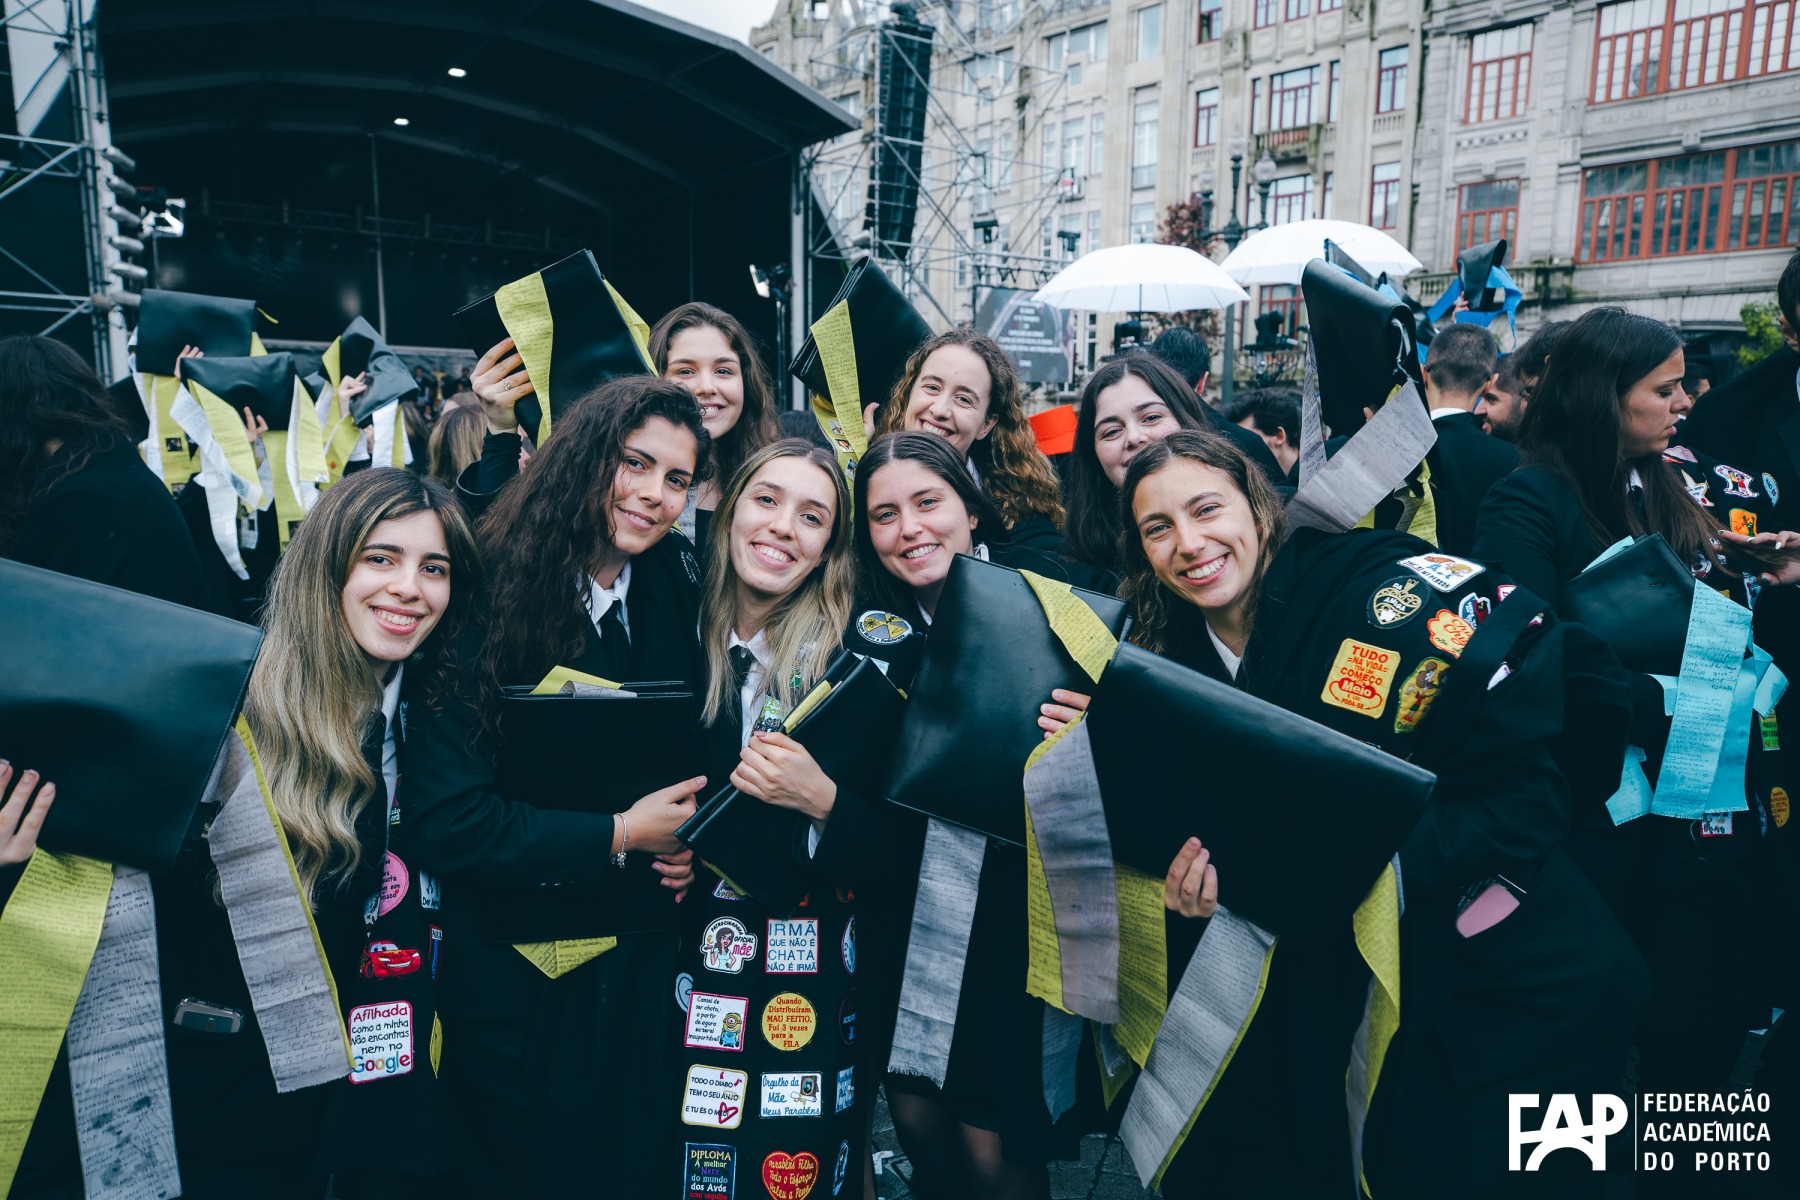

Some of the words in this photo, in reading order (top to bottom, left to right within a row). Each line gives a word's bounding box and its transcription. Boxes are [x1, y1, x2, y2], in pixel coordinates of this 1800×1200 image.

[1383, 597, 1406, 611] AMIGA
[1352, 645, 1388, 663] TUDO
[1366, 660, 1382, 672] VIDA
[1341, 667, 1382, 685] COMEÇO
[1342, 680, 1372, 697] Meio
[711, 920, 743, 935] PATROCINADORA
[769, 921, 816, 936] IRMÃ
[789, 938, 807, 946] NÃO
[810, 938, 815, 946] É
[768, 950, 815, 960] CHATA
[767, 962, 785, 971] NÃO
[788, 962, 793, 971] É
[797, 962, 816, 971] IRMÃ
[354, 1004, 408, 1022] Afilhada
[352, 1025, 374, 1033] como
[384, 1019, 408, 1029] minha
[368, 1030, 409, 1042] encontras
[362, 1046, 384, 1054] nem
[389, 1043, 402, 1051] no
[352, 1051, 410, 1073] Google
[715, 1080, 733, 1088] DIABO
[763, 1075, 788, 1089] Orgulho
[790, 1077, 799, 1086] da
[768, 1093, 787, 1103] Mãe
[700, 1106, 706, 1114] ÉS
[785, 1106, 820, 1115] Parabéns
[691, 1150, 731, 1161] DIPLOMA
[769, 1158, 795, 1170] Parabéns
[798, 1158, 814, 1169] Filha
[702, 1167, 718, 1175] Neta
[770, 1170, 781, 1182] Todo
[784, 1176, 787, 1184] o
[790, 1173, 812, 1187] Esforço
[691, 1182, 704, 1190] dos
[707, 1183, 726, 1192] Avós
[789, 1191, 793, 1199] a
